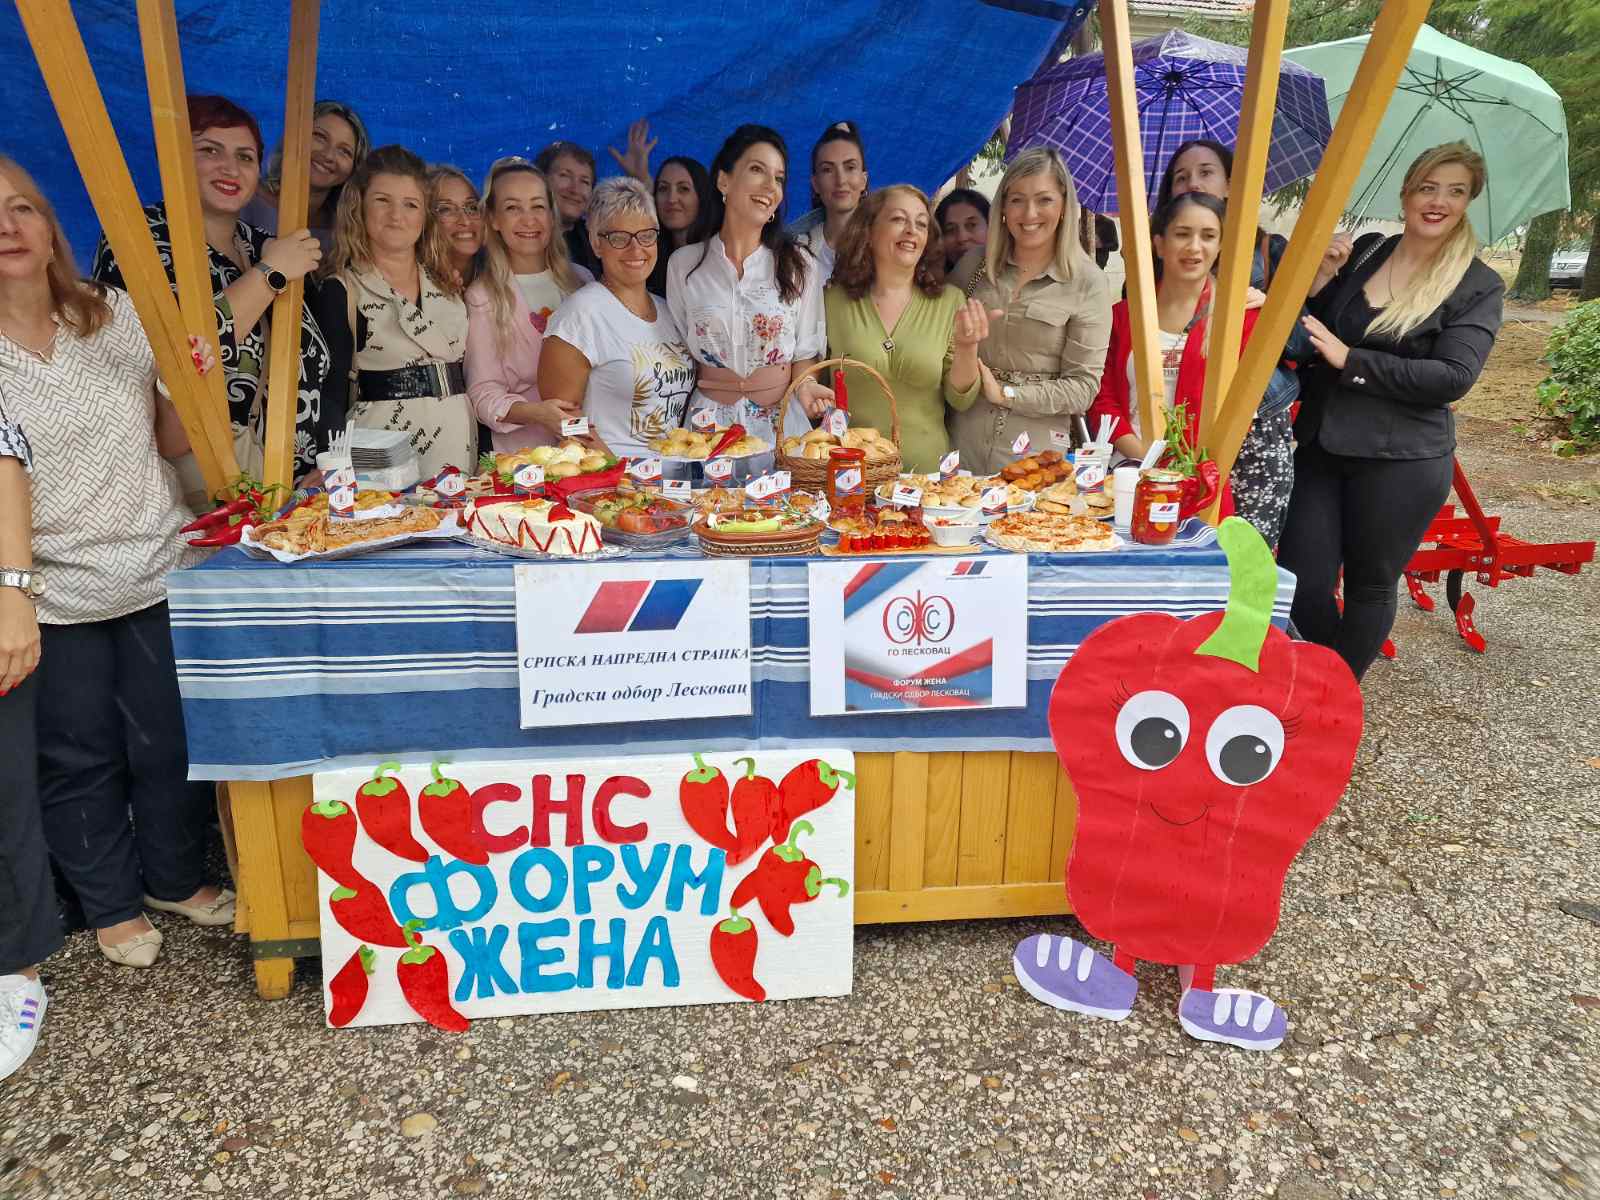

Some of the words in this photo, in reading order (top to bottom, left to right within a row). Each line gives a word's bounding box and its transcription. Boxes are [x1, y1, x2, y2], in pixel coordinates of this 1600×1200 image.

[523, 654, 586, 669] СРПСКА
[591, 650, 676, 666] НАПРЕДНА
[682, 648, 750, 662] СТРАНКА
[887, 648, 899, 656] ГО
[902, 646, 951, 656] ЛЕСКОВАЦ
[893, 679, 923, 687] ФОРУМ
[924, 677, 947, 686] ЖЕНА
[931, 689, 970, 697] ЛЕСКОВАЦ
[532, 688, 607, 708] Градски
[611, 684, 663, 703] одбор
[666, 682, 748, 698] Лесковац
[470, 773, 652, 853] СНС
[389, 843, 727, 932] ФОРУМ
[448, 915, 680, 1002] ЖЕНА
